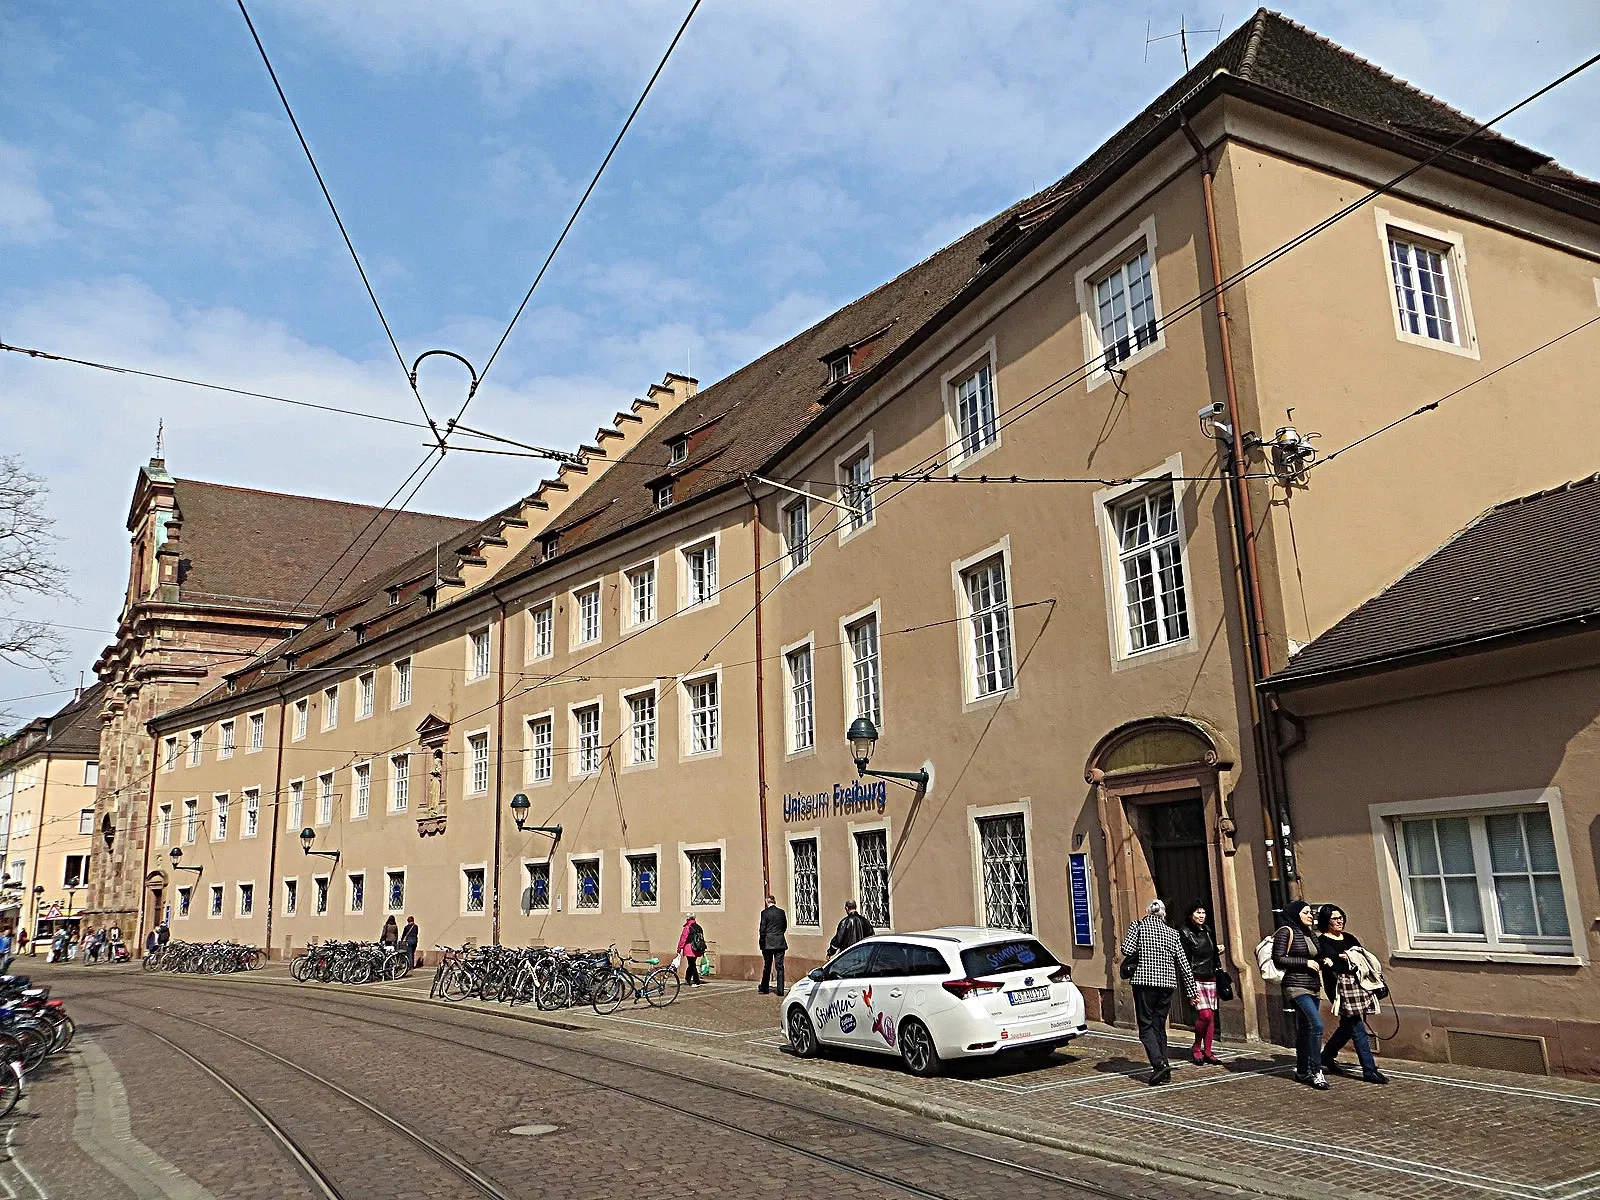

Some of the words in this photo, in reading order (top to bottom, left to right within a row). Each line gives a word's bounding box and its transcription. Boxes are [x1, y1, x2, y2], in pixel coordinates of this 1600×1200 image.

[783, 791, 829, 815] Uniseum
[833, 780, 886, 808] Freiburg
[816, 998, 856, 1029] Stimmen
